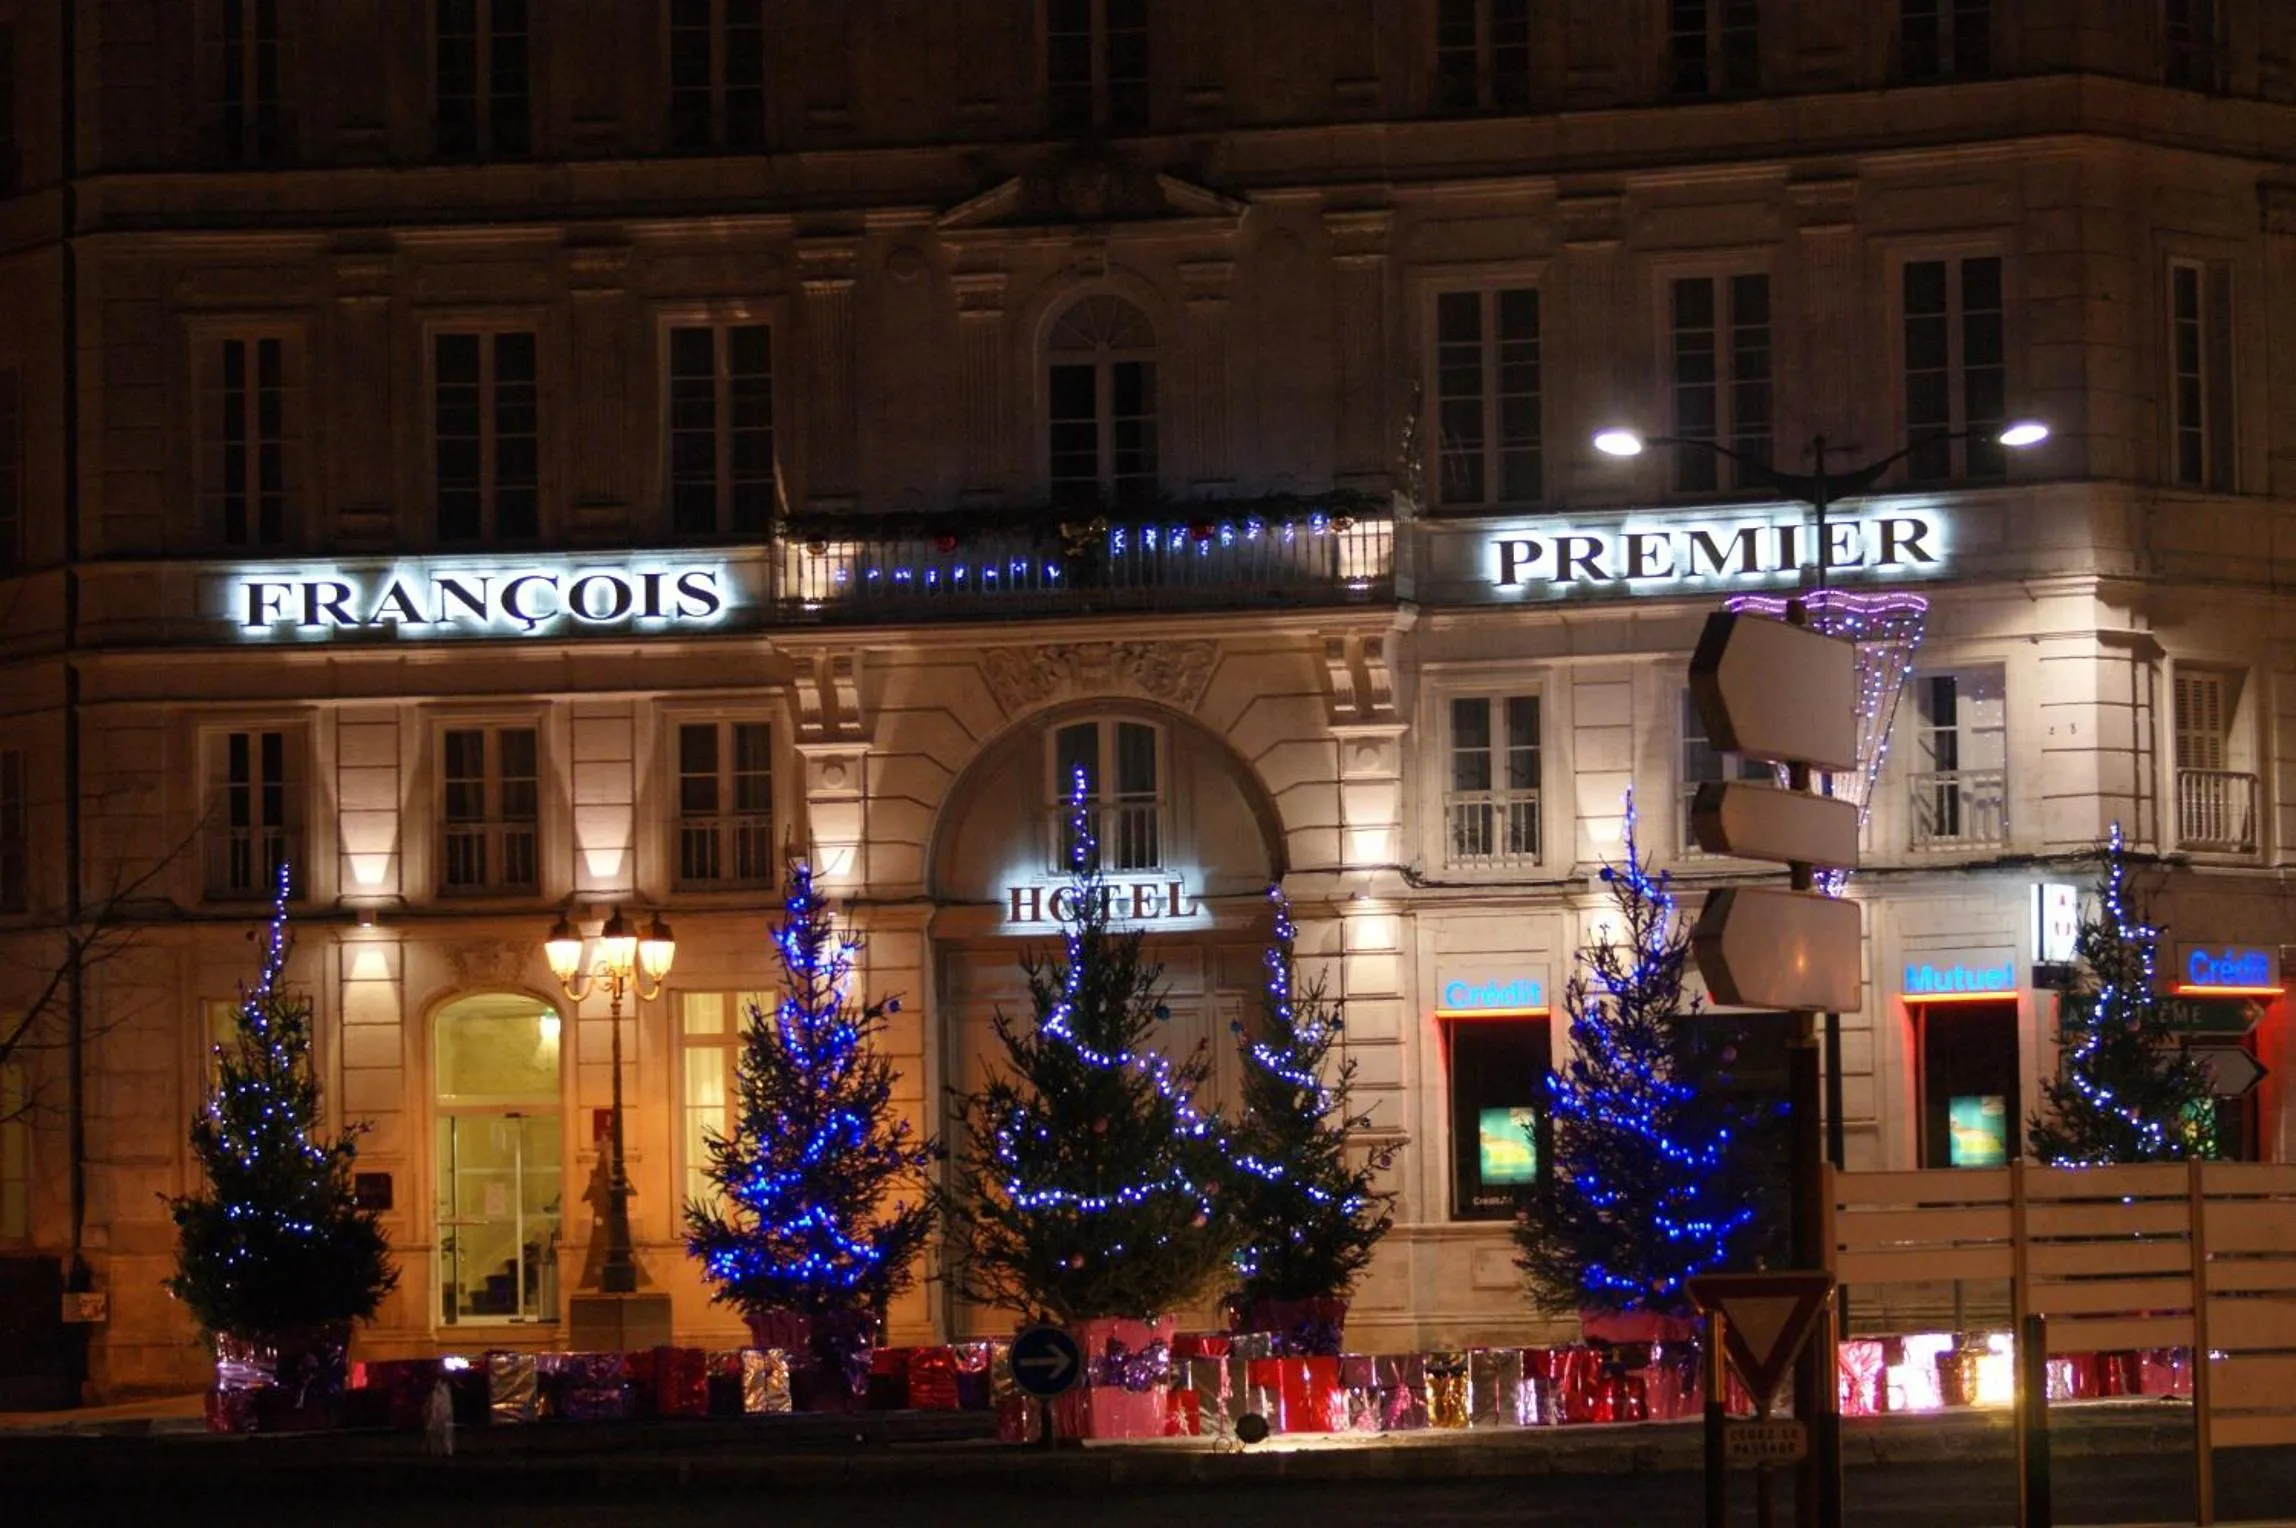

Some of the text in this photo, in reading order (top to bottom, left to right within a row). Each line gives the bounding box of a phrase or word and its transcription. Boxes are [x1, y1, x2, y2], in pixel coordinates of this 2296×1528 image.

[1491, 518, 1940, 587] PREMIER
[239, 570, 721, 631] FRANÇOIS
[1007, 881, 1200, 923] HOTEL
[1904, 961, 2014, 992] Mutuel
[2189, 947, 2269, 986] Crédit
[1445, 979, 1542, 1008] Crédit
